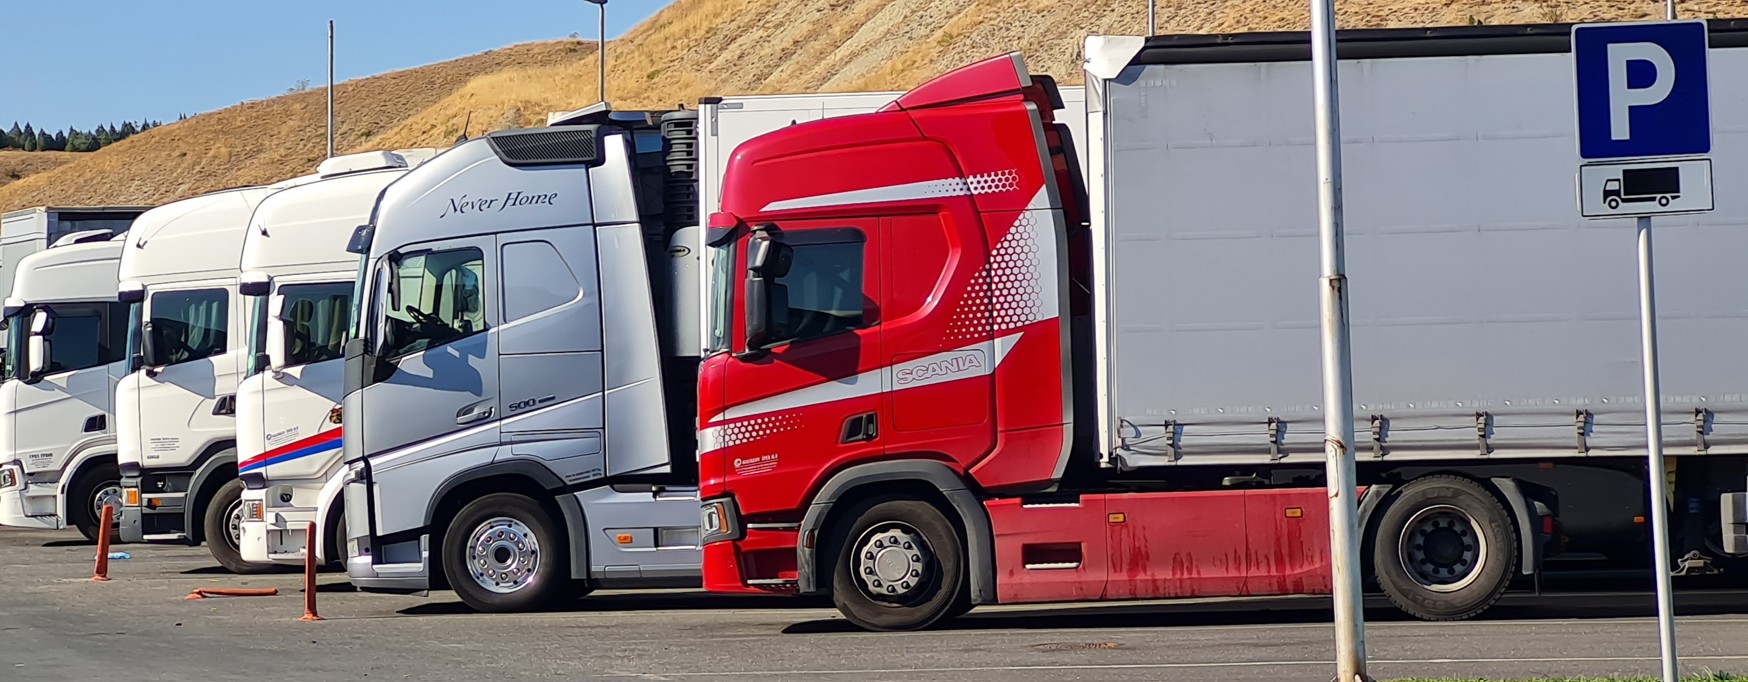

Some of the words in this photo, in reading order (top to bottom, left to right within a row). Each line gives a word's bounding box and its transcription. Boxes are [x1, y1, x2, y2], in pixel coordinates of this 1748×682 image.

[1607, 41, 1676, 141] P
[439, 194, 498, 219] Never
[498, 191, 558, 212] Home
[896, 353, 982, 385] SCANIA
[508, 398, 536, 412] 500
